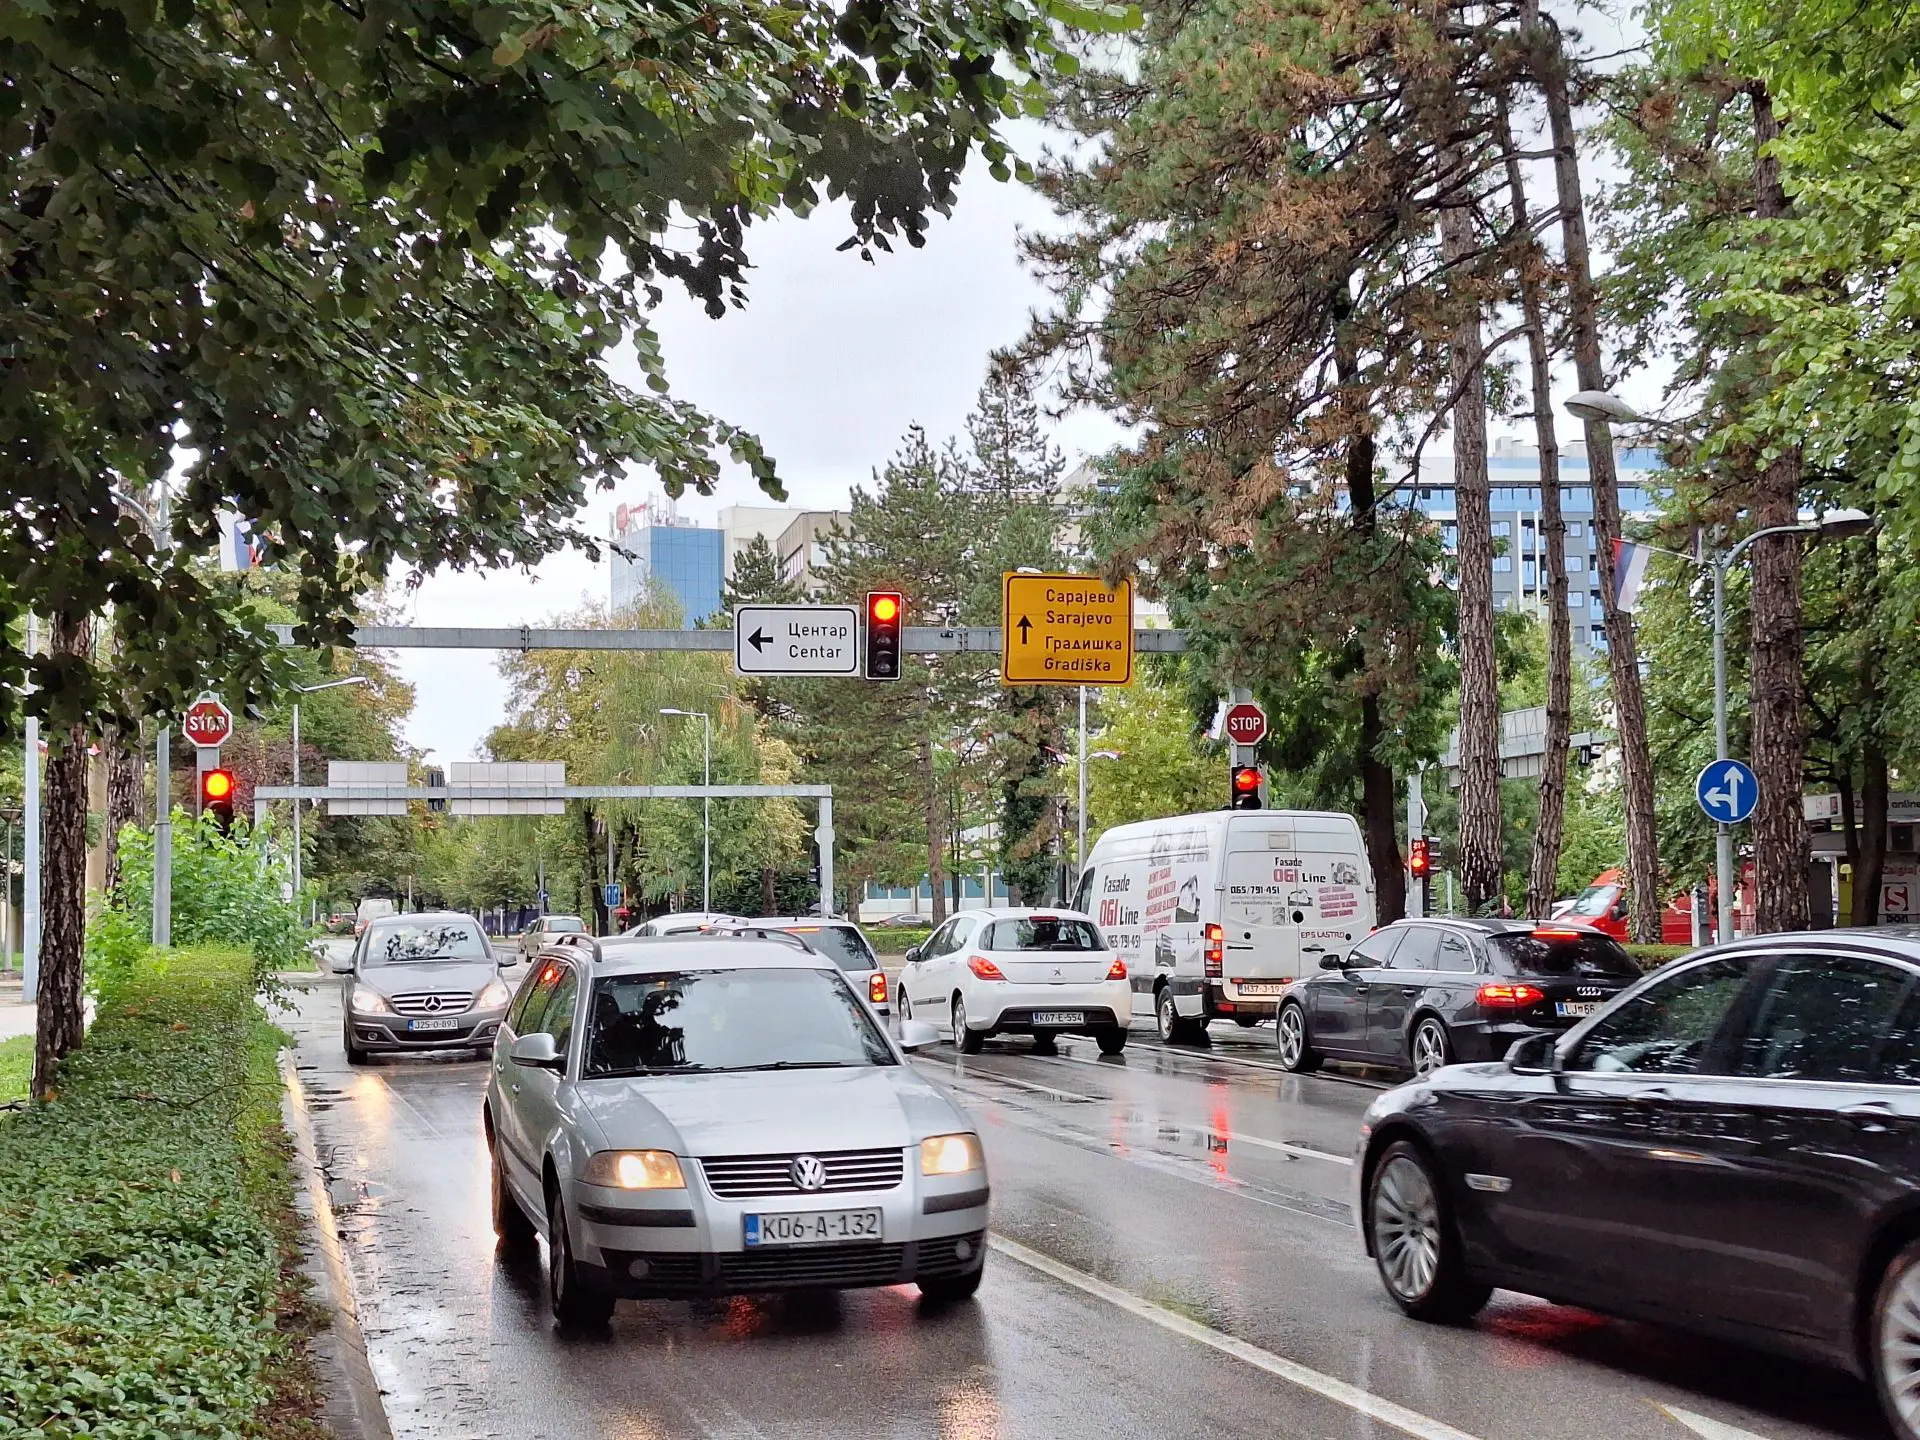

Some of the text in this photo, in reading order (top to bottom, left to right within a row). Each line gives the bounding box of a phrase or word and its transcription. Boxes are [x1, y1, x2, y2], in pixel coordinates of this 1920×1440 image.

[1046, 589, 1115, 606] Сарајево
[1046, 610, 1112, 627] Sarajevo
[789, 622, 847, 639] Центар
[789, 644, 842, 658] Centar
[1045, 636, 1122, 653] Градишка
[1044, 658, 1111, 671] Gradiška
[1230, 717, 1261, 731] STOP
[1274, 857, 1302, 867] Fasade
[1103, 873, 1130, 893] Fasade
[1273, 869, 1326, 883] OGI Line
[1099, 899, 1119, 926] OGI
[1120, 905, 1139, 925] Line
[1040, 1013, 1082, 1022] K67-E-554
[762, 1213, 878, 1239] K06-A-132
